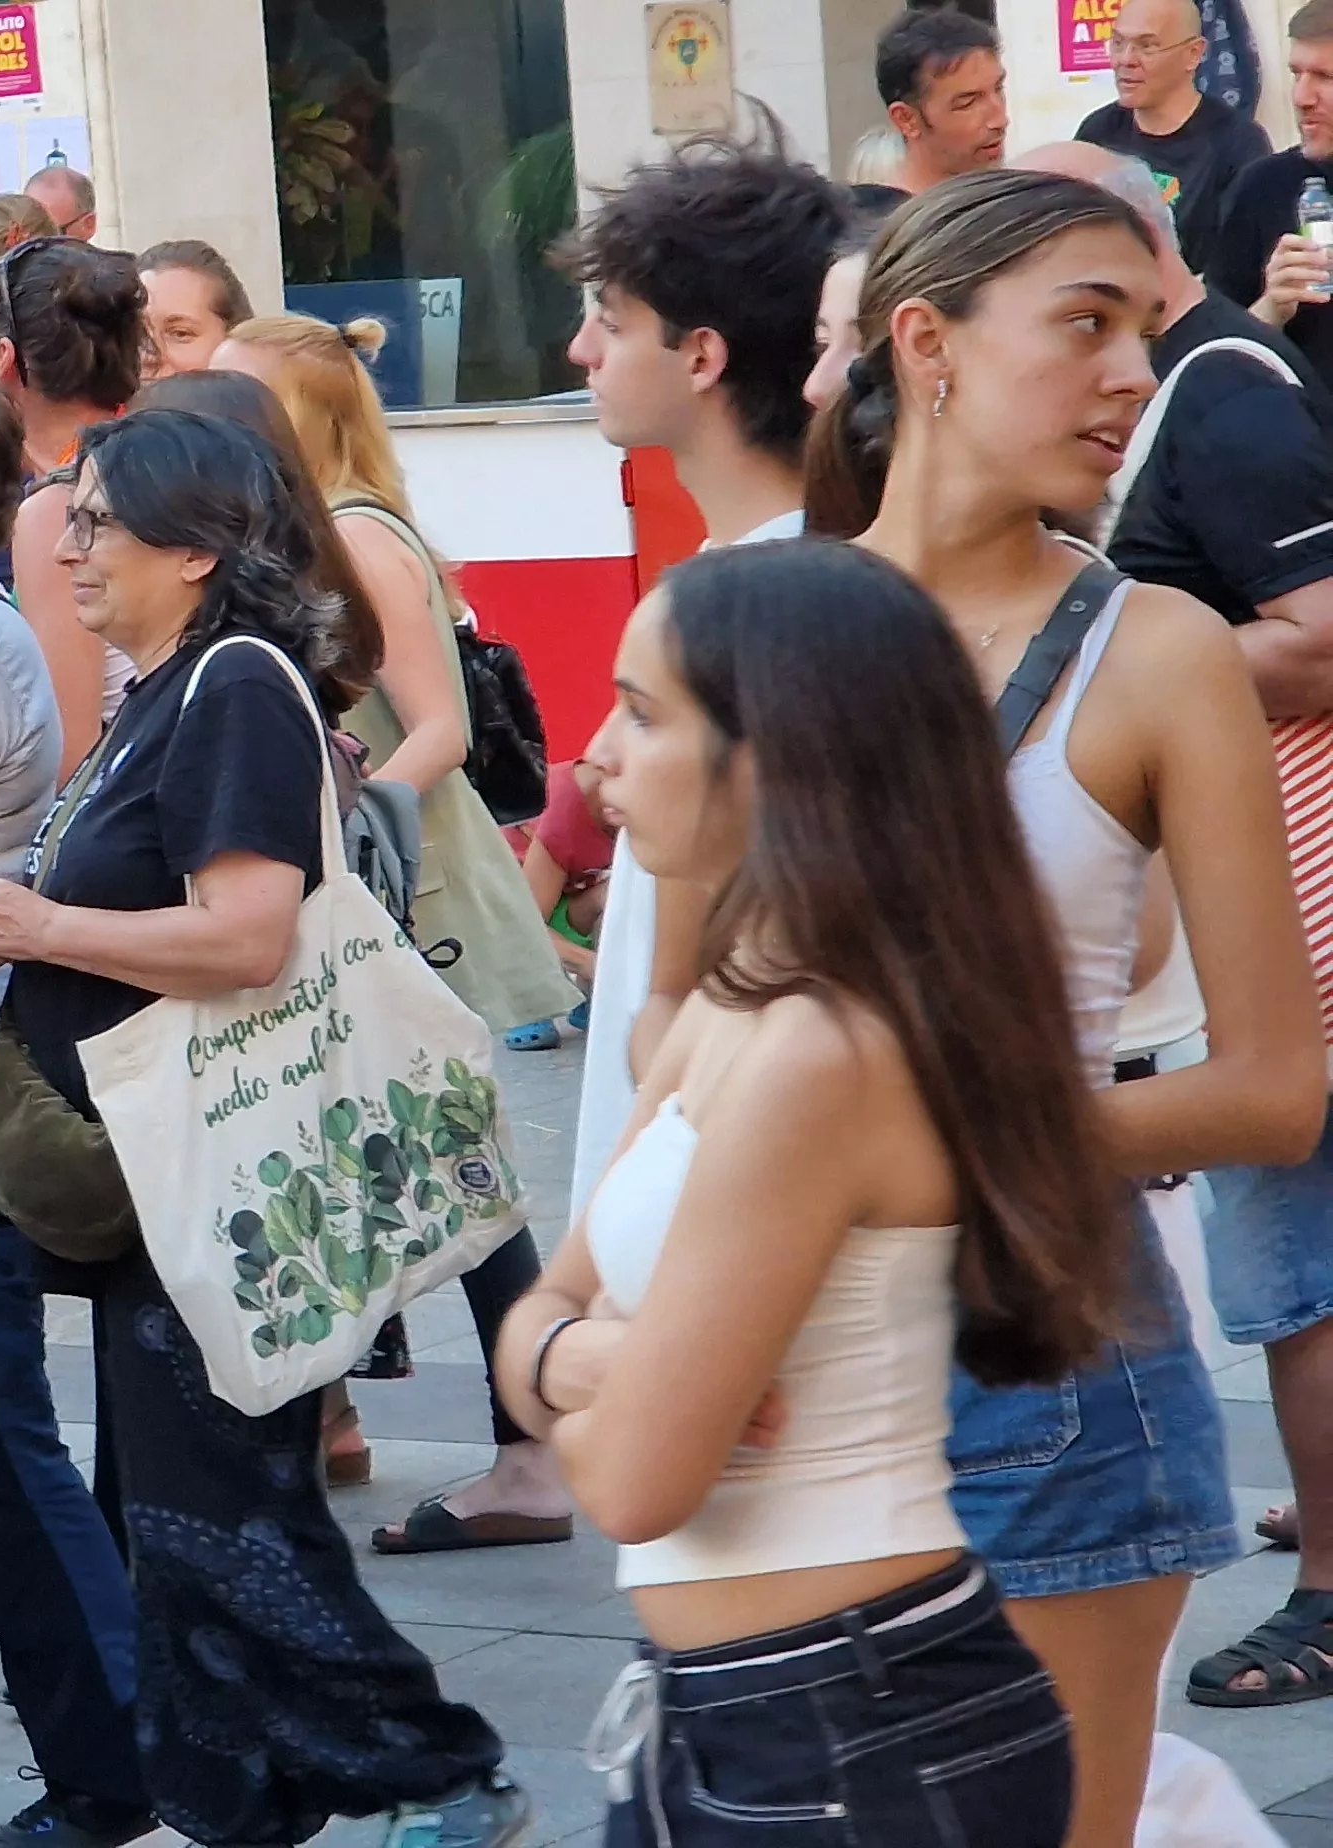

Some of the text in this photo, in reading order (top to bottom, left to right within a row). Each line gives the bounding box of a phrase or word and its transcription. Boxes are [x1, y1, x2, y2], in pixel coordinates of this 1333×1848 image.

[1073, 0, 1123, 20] ALC
[1072, 22, 1090, 43] A
[419, 290, 454, 318] SCA
[343, 937, 384, 965] con
[204, 1065, 271, 1129] medio
